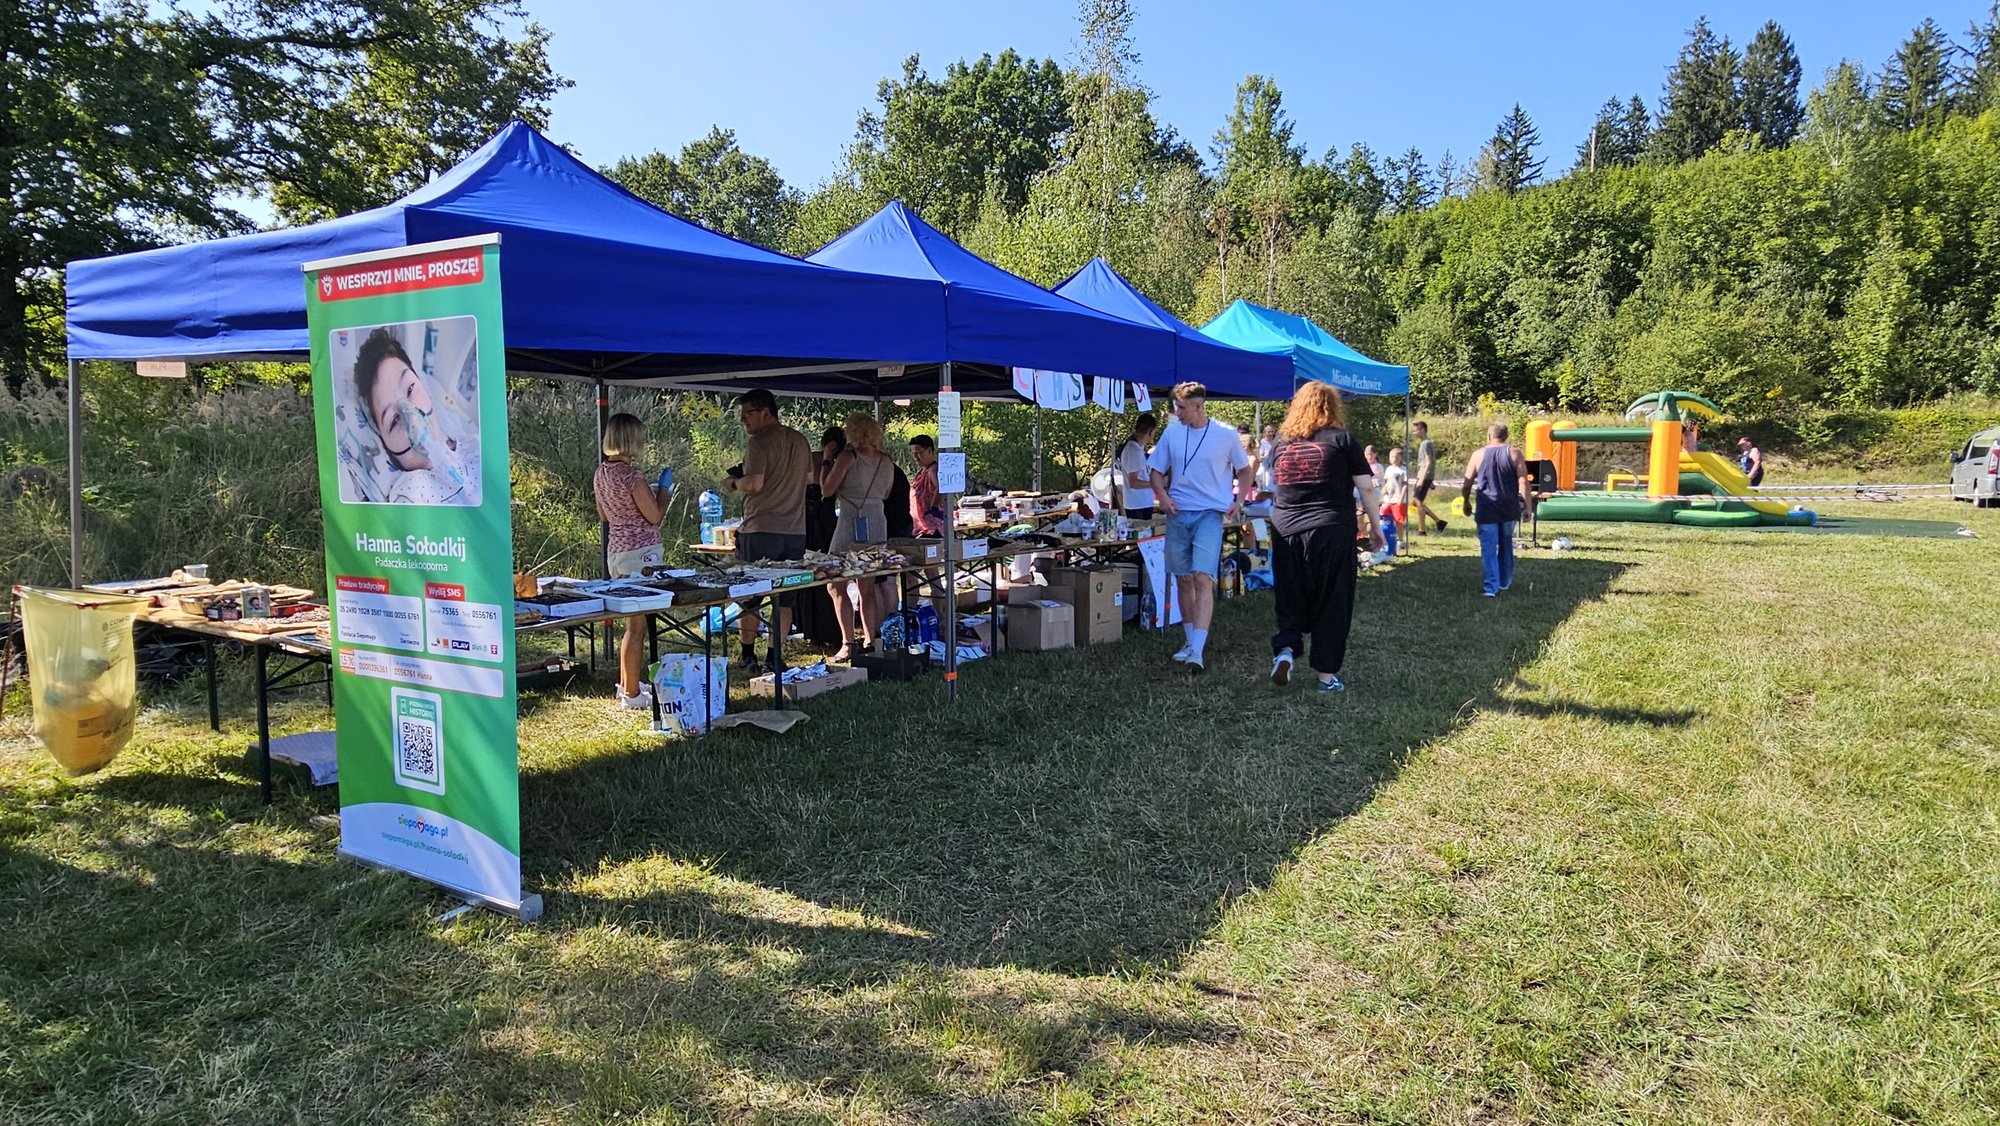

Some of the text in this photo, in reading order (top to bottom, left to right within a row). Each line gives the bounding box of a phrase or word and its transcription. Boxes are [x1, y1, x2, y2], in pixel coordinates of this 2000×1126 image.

[336, 257, 479, 290] WESPRZYJ MNIE, PROSZĘ!
[356, 532, 466, 562] Hanna Sołodkij
[375, 557, 406, 568] Padaczka
[447, 588, 461, 598] SMS
[442, 607, 459, 616] 75365
[472, 610, 496, 619] 0556761
